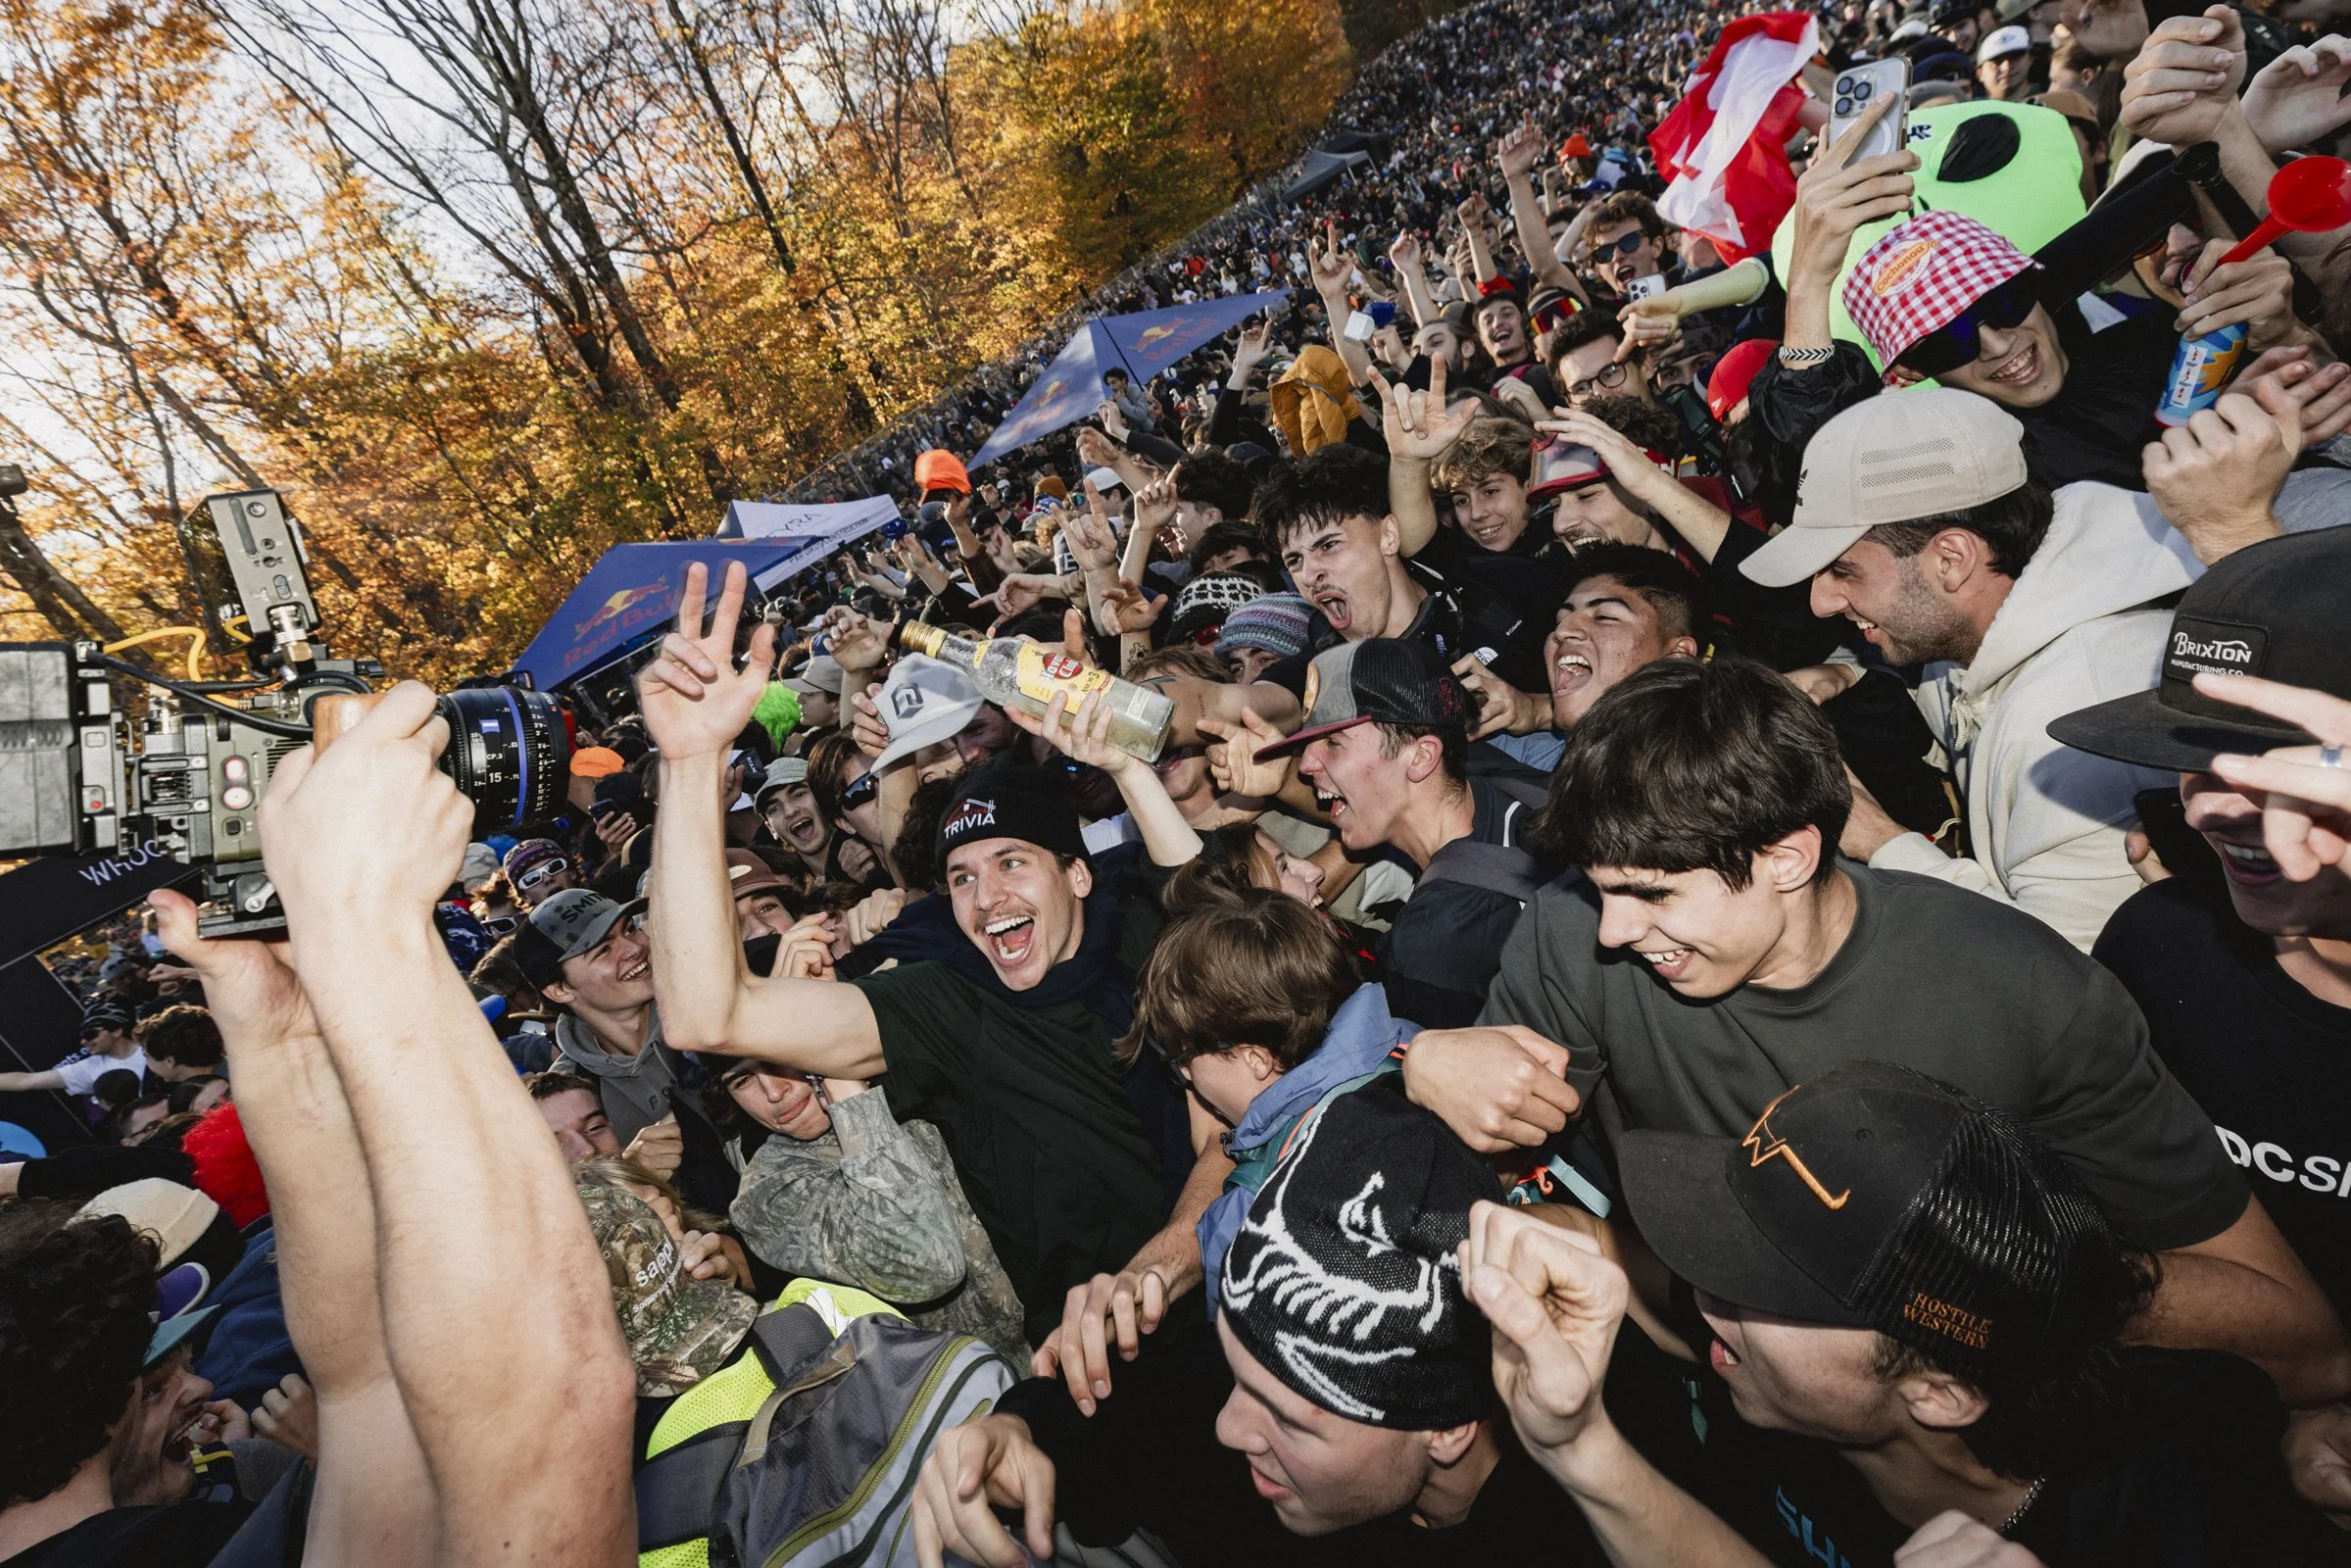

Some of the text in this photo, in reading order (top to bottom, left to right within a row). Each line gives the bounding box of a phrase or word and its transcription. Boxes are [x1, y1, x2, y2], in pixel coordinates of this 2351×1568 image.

[563, 618, 618, 669] Red
[488, 772, 503, 784] 15
[944, 811, 996, 840] TRIVIA
[1904, 1303, 1990, 1349] WESTERN
[1912, 1292, 1992, 1335] HOSTILE
